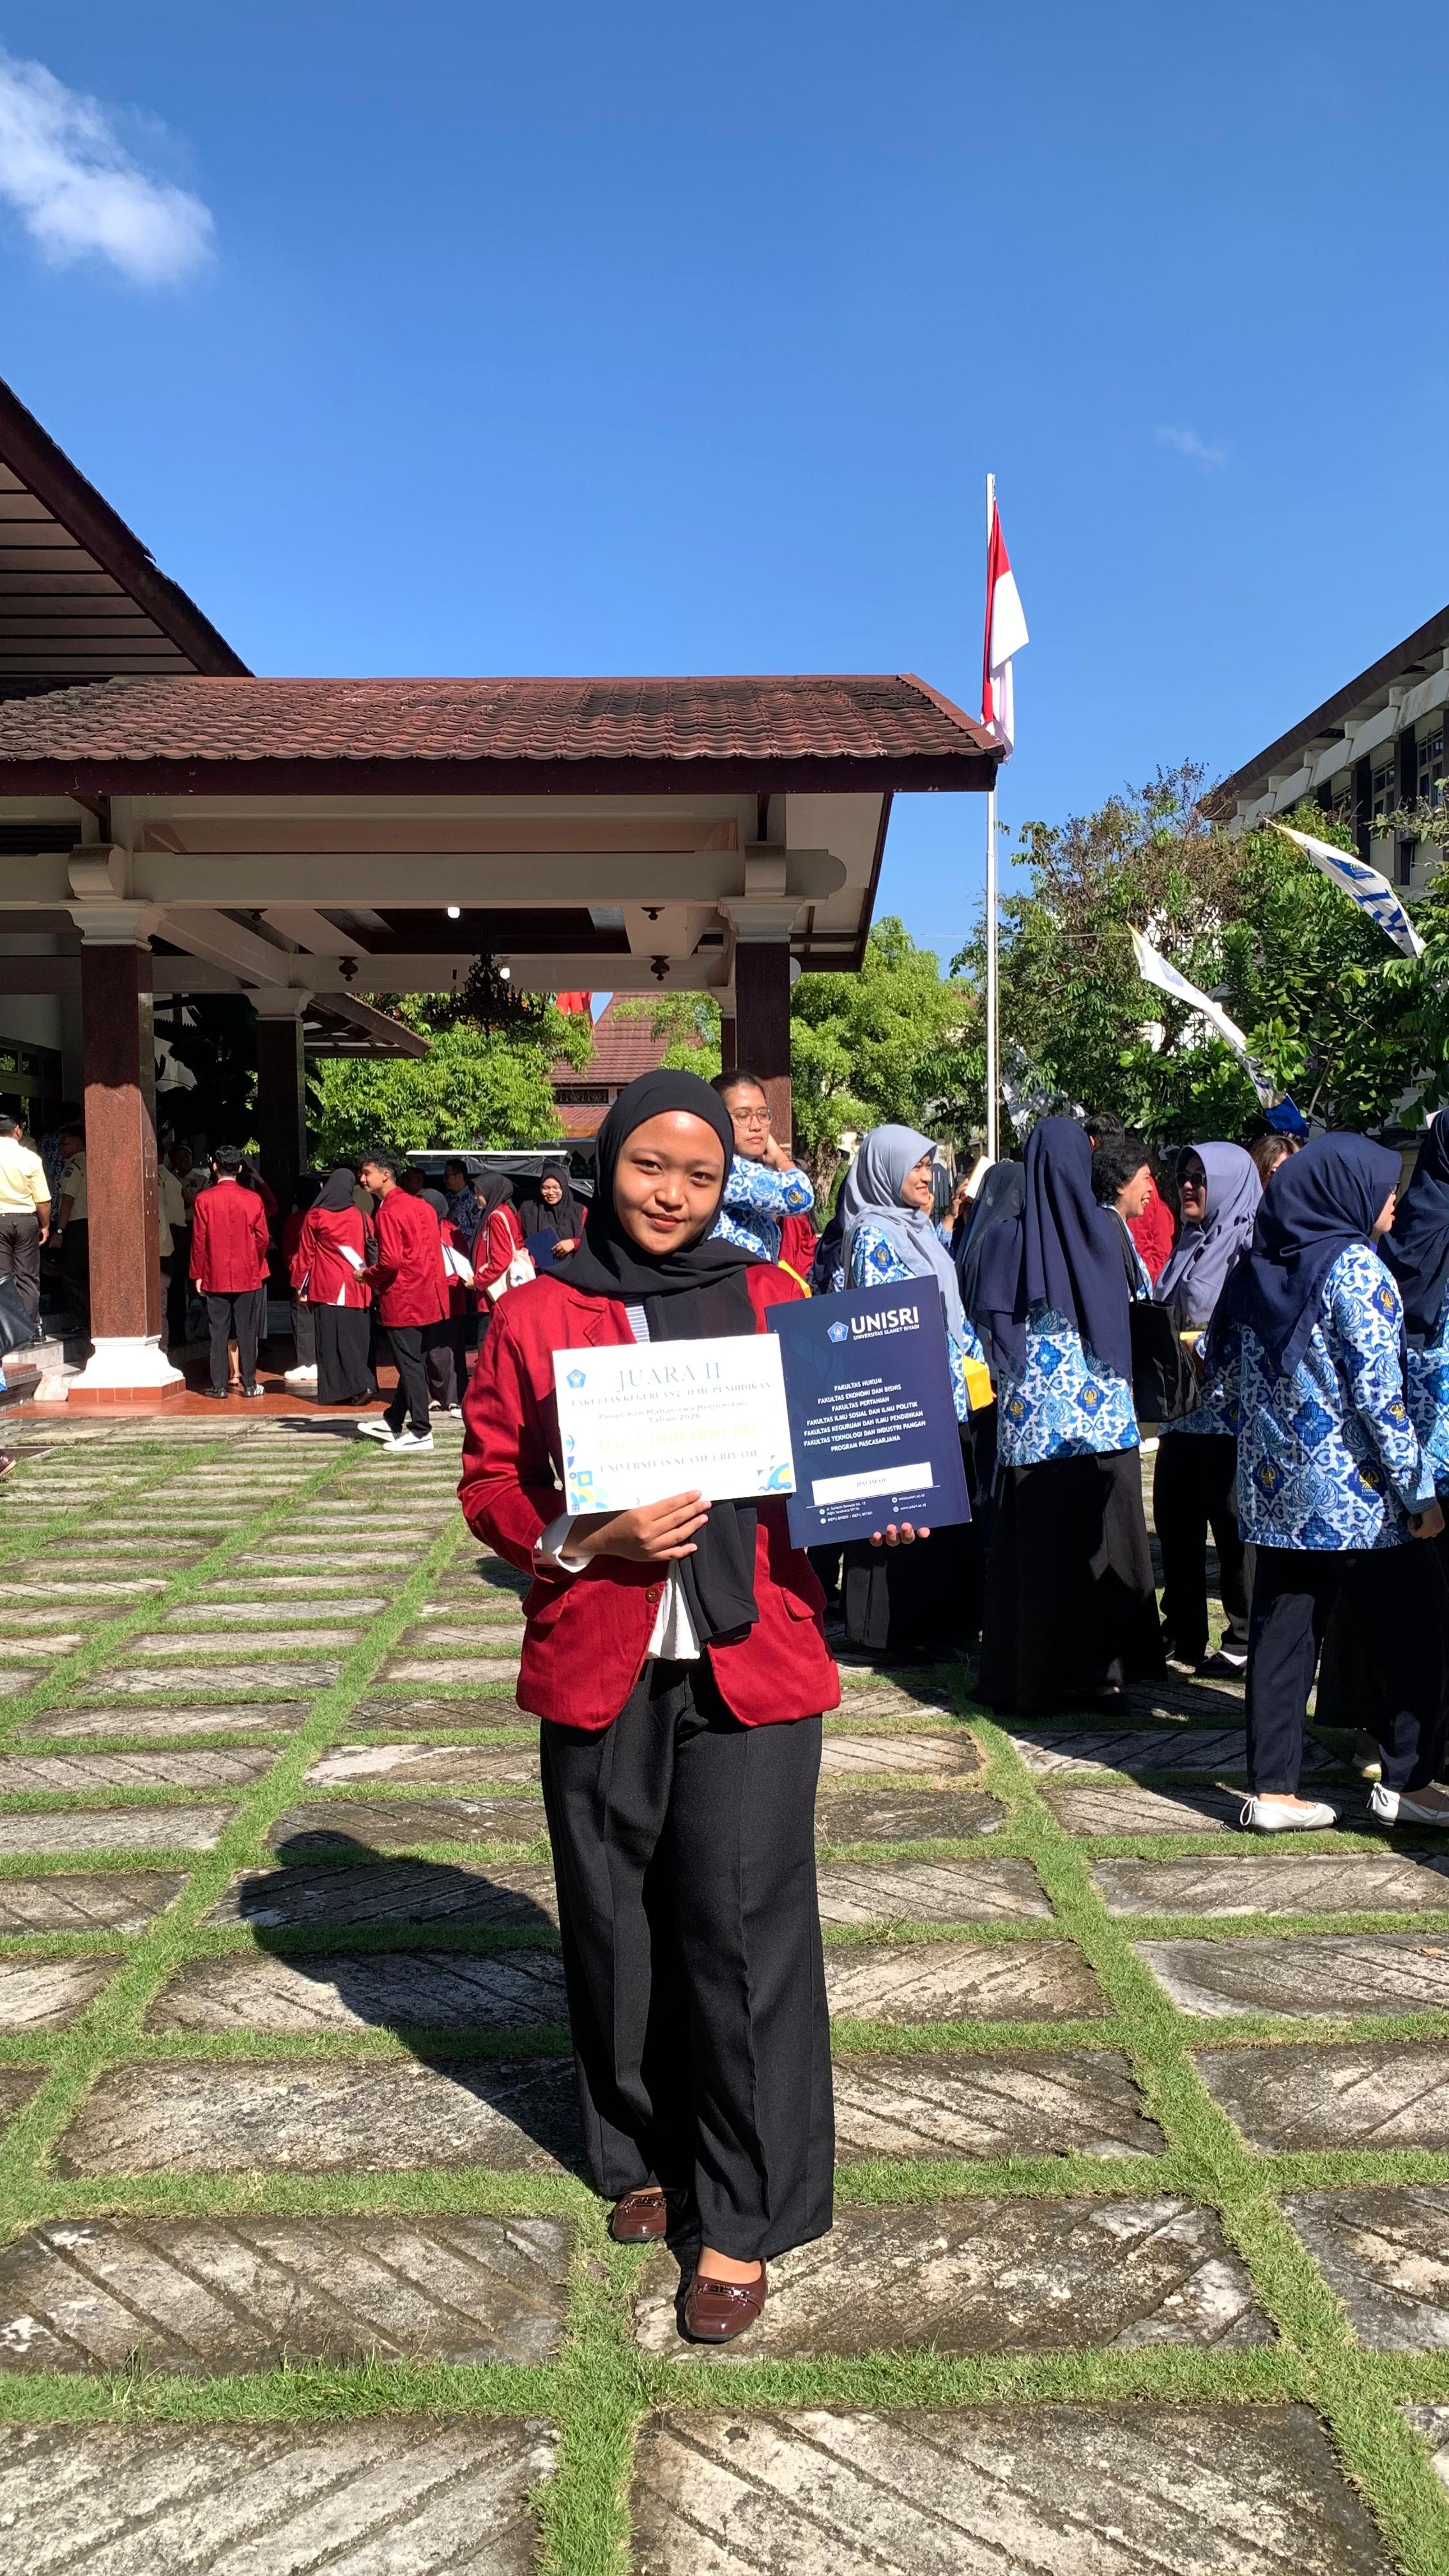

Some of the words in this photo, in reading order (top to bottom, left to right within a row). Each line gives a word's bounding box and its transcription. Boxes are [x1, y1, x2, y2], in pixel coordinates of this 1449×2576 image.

[850, 1306, 919, 1334] UNISRI
[853, 1330, 884, 1340] UNIVERSITAS
[884, 1326, 903, 1335] SLAMET
[617, 1365, 696, 1393] JUARA
[705, 1362, 720, 1379] II
[834, 1381, 861, 1392] FAKULTAS
[861, 1377, 883, 1386] HUKUM
[817, 1394, 845, 1405] FAKULTAS
[845, 1390, 871, 1400] EKONOMI
[884, 1384, 901, 1393] BISNIS
[831, 1402, 859, 1412] FAKULTAS
[859, 1396, 890, 1407] PERTANIAN
[804, 1426, 831, 1437] FAKULTAS
[831, 1421, 862, 1432] KEGURUAN
[875, 1416, 889, 1424] ILMU
[889, 1410, 924, 1422] PENDIDIKAN
[806, 1416, 834, 1427] FAKULTAS
[834, 1413, 848, 1422] ILMU
[848, 1410, 868, 1419] SOSIAL
[868, 1407, 880, 1416] DAN
[881, 1405, 895, 1413] ILMU
[896, 1401, 918, 1411] POLITIK
[803, 1436, 831, 1447] FAKULTAS
[831, 1431, 863, 1442] TEKNOLOGI
[876, 1424, 902, 1434] INDUSTRI
[903, 1420, 926, 1430] PANGAN
[831, 1442, 858, 1452] PROGRAM
[858, 1434, 901, 1448] PASCASARJANA
